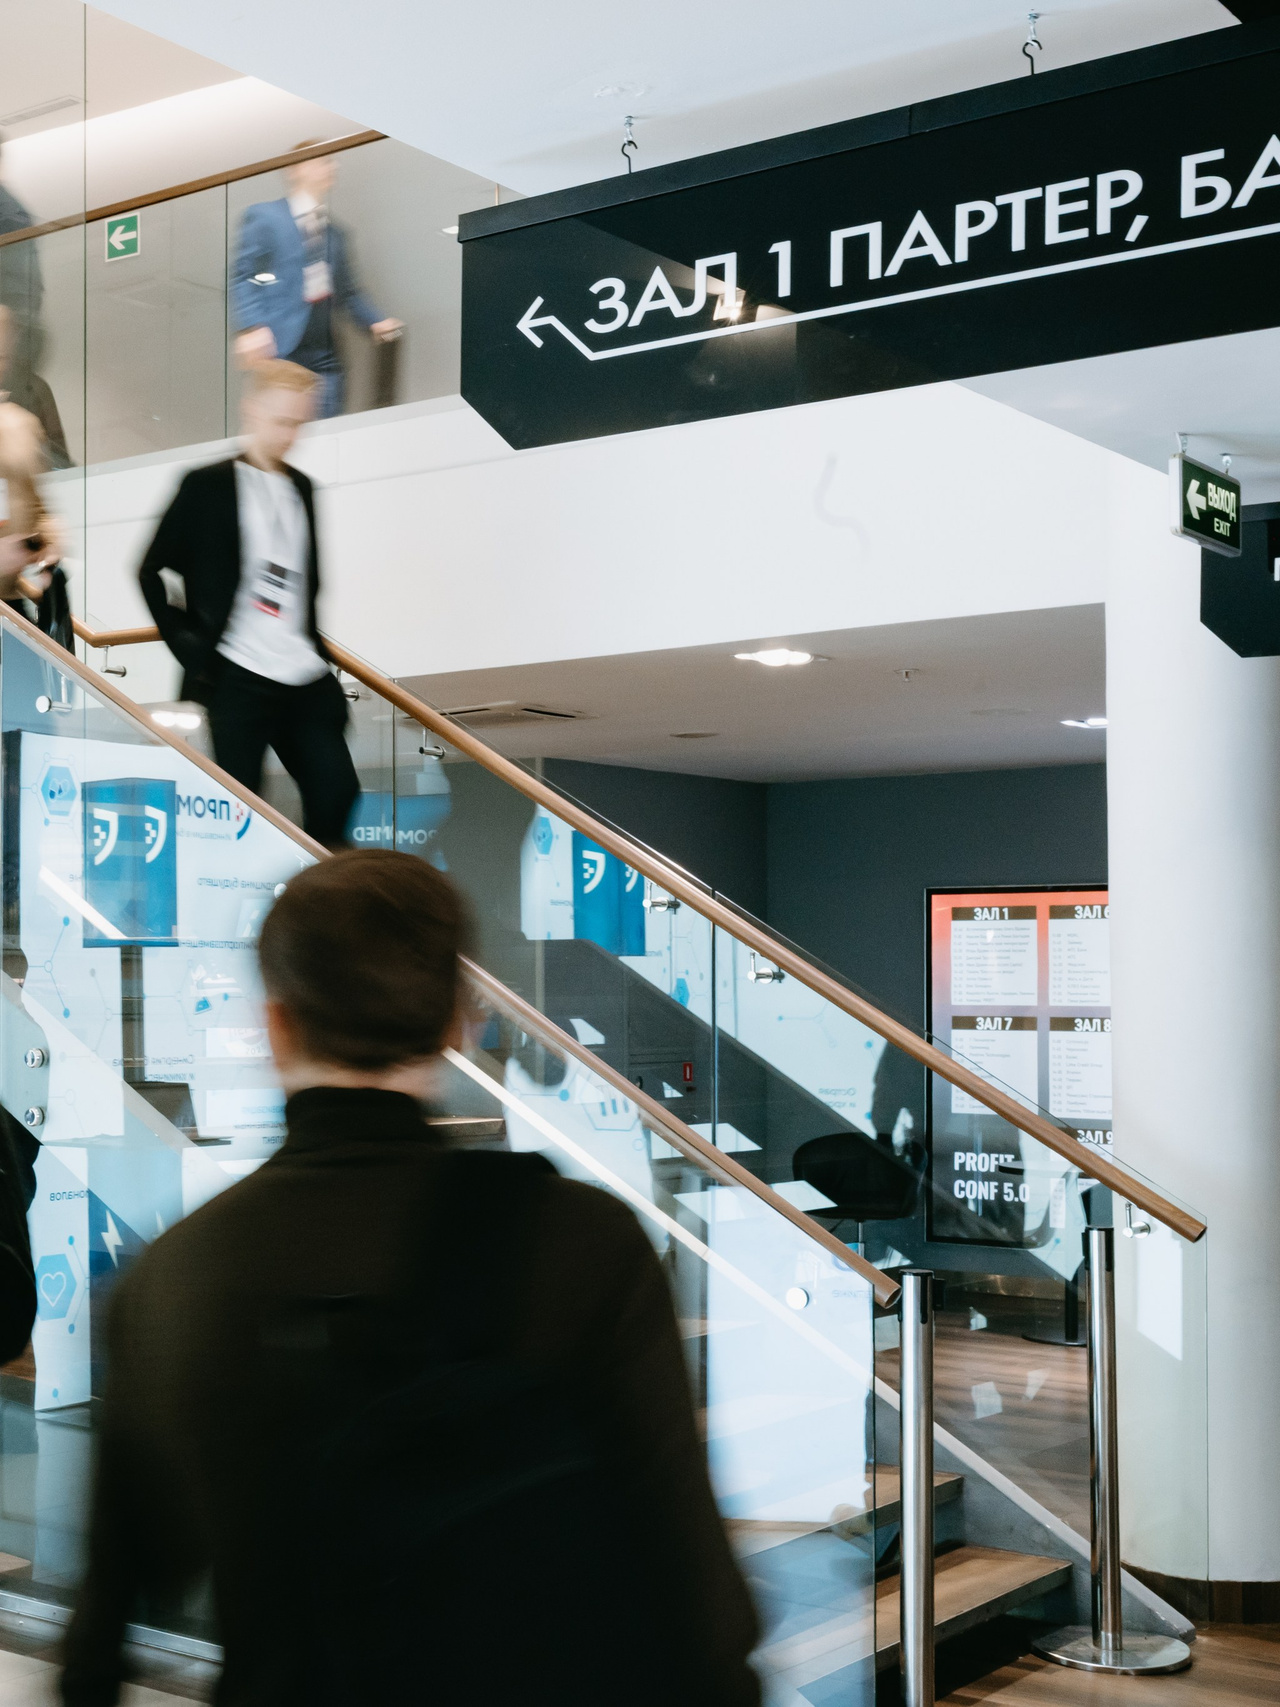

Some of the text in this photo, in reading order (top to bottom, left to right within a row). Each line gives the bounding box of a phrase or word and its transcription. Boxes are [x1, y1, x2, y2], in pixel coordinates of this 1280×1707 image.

[584, 252, 737, 334] ЗАЛ
[768, 240, 792, 298] 1
[829, 169, 1149, 288] ПАРТЕР,
[1207, 482, 1237, 523] ВЫХОД
[1213, 517, 1231, 537] EXIT
[973, 907, 1009, 921] ЗАЛ 1
[1074, 905, 1101, 919] ЗАЛ
[975, 1016, 1013, 1030] ЗАЛ 7
[1074, 1018, 1112, 1032] ЗАЛ 8
[1076, 1129, 1113, 1144] ЗАЛ 9
[953, 1179, 1030, 1203] CONF 5.0
